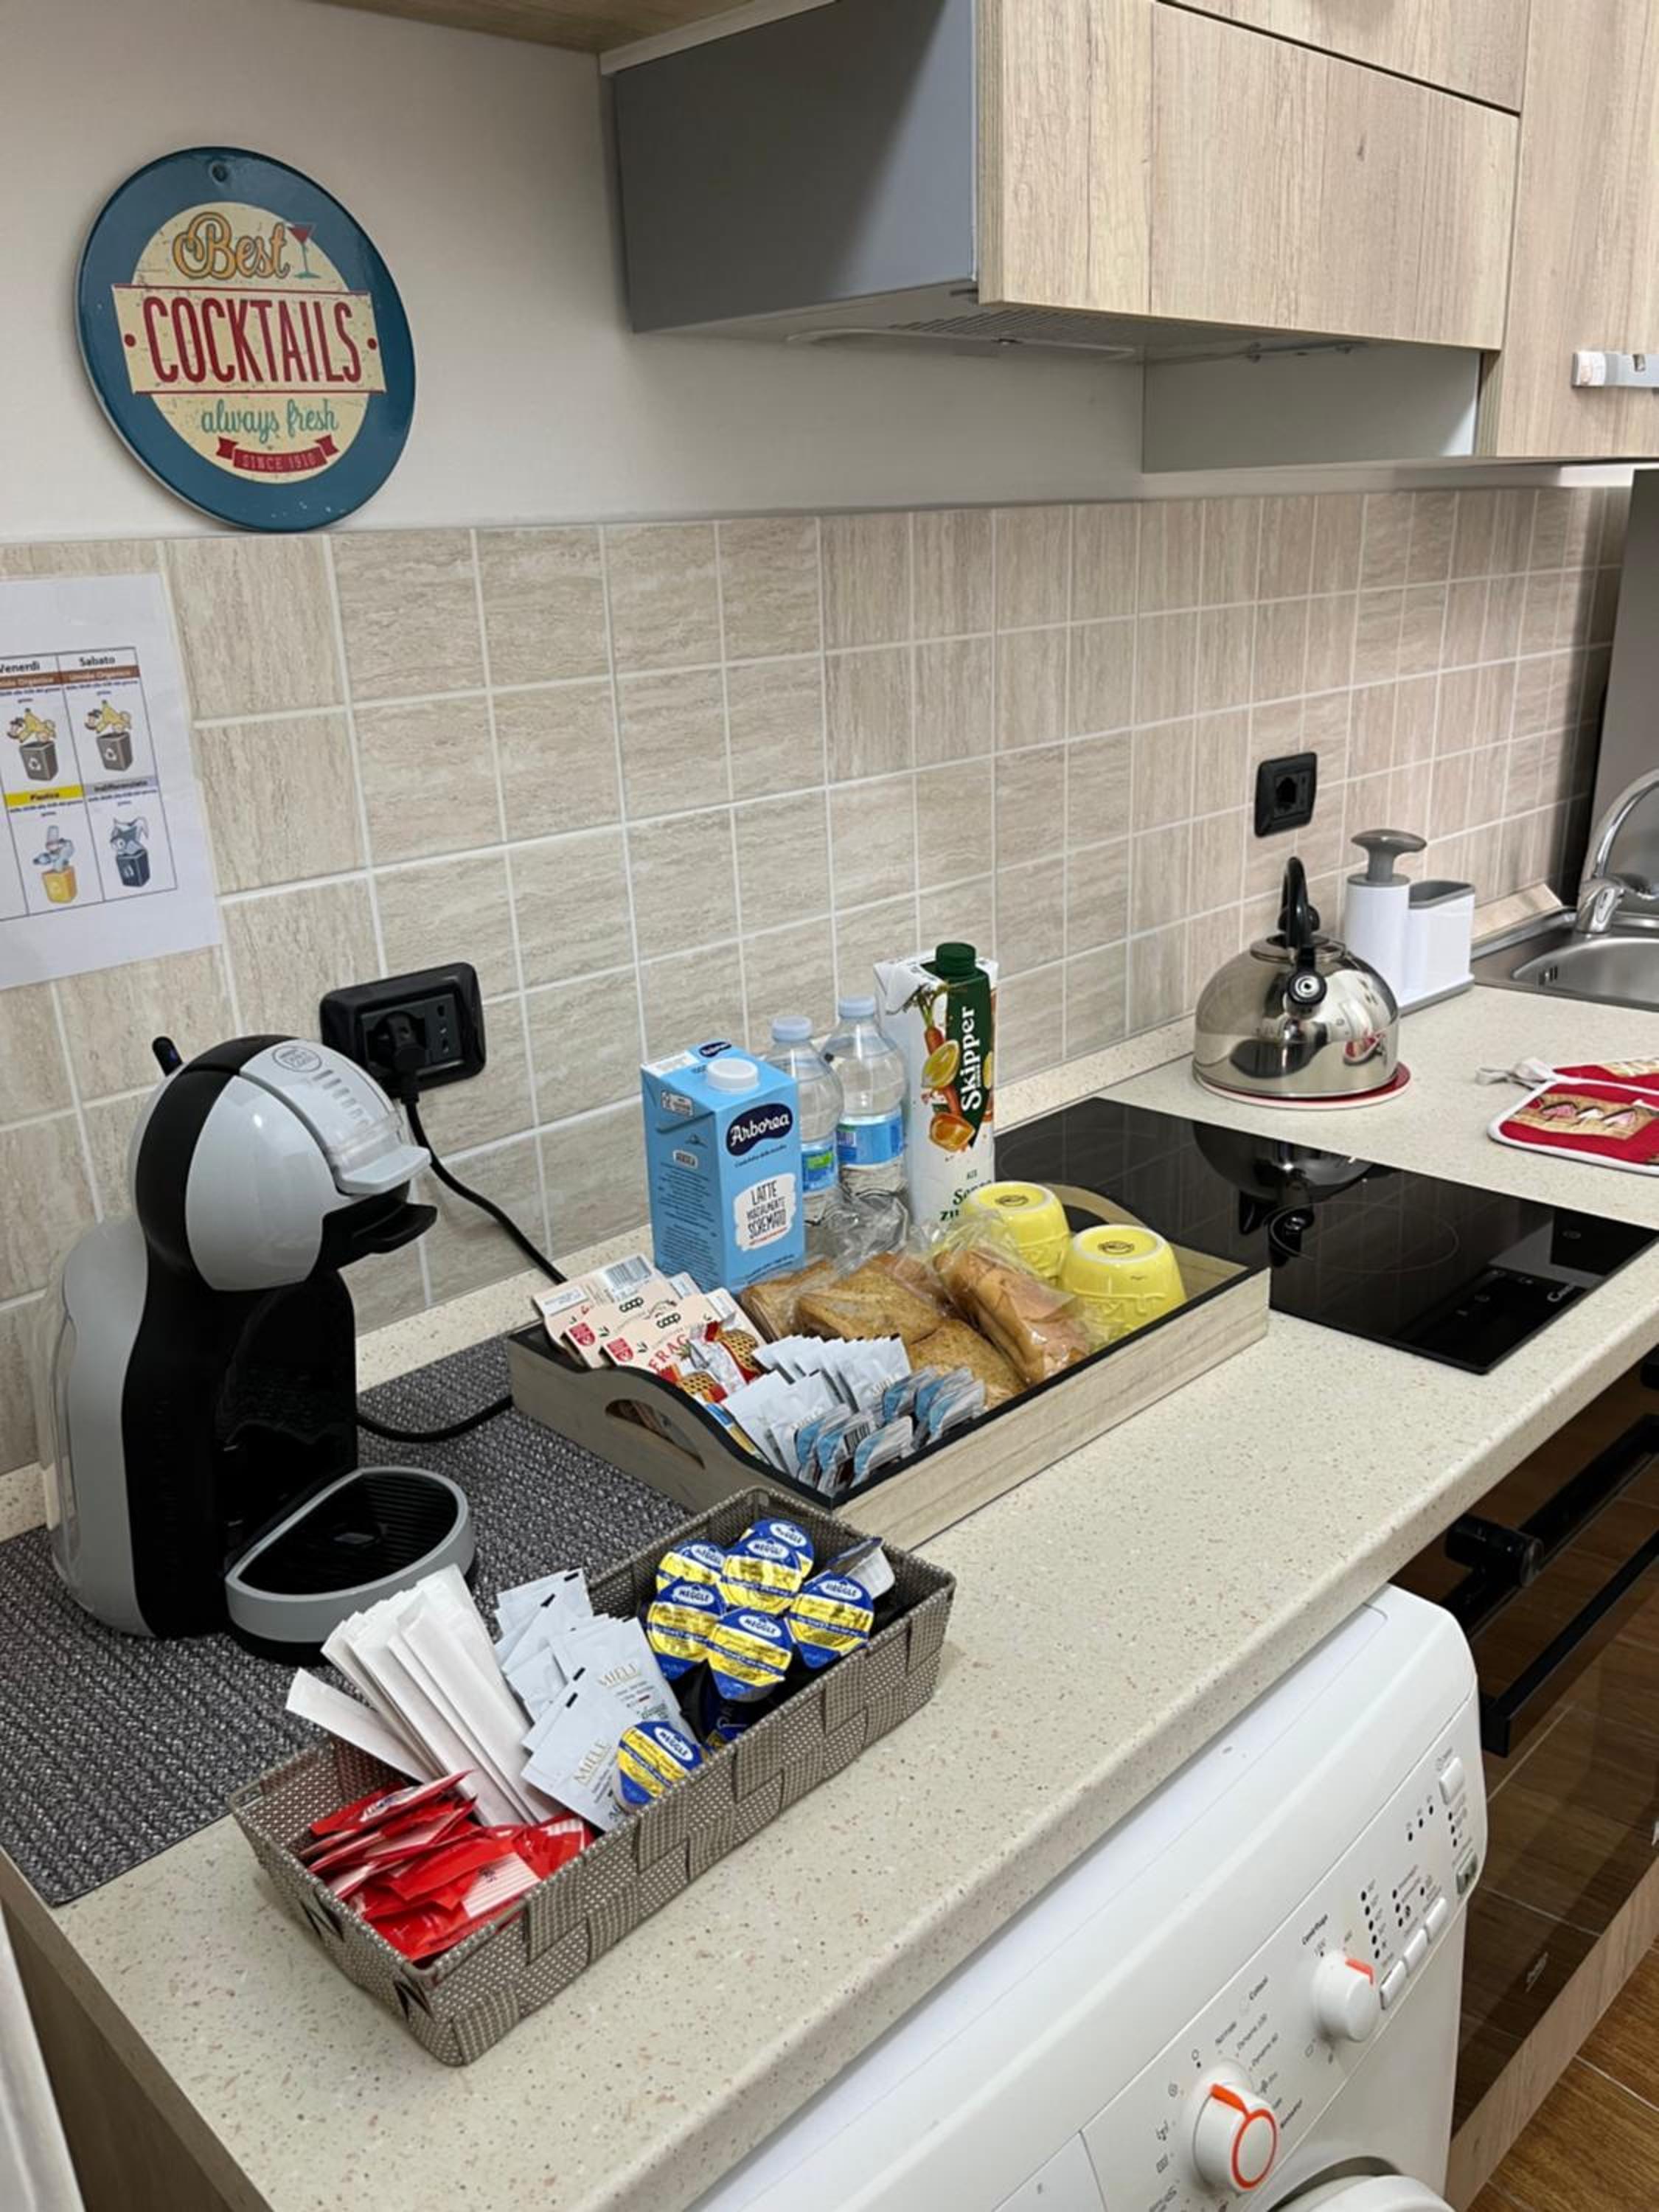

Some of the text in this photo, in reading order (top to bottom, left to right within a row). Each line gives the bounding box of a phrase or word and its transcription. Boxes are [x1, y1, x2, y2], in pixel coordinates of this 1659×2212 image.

[172, 211, 291, 279] Best
[142, 296, 362, 383] COCKTAILS
[201, 397, 340, 444] always fresh
[243, 453, 283, 470] SINCE
[79, 655, 116, 667] Sabato
[960, 1005, 985, 1112] Skipper
[729, 1113, 790, 1147] Arborea
[750, 1180, 777, 1206] LATTE
[619, 1296, 644, 1312] coop
[656, 1312, 681, 1329] coop
[678, 1588, 709, 1602] MEGGLE
[744, 1618, 776, 1635] MEGGLE
